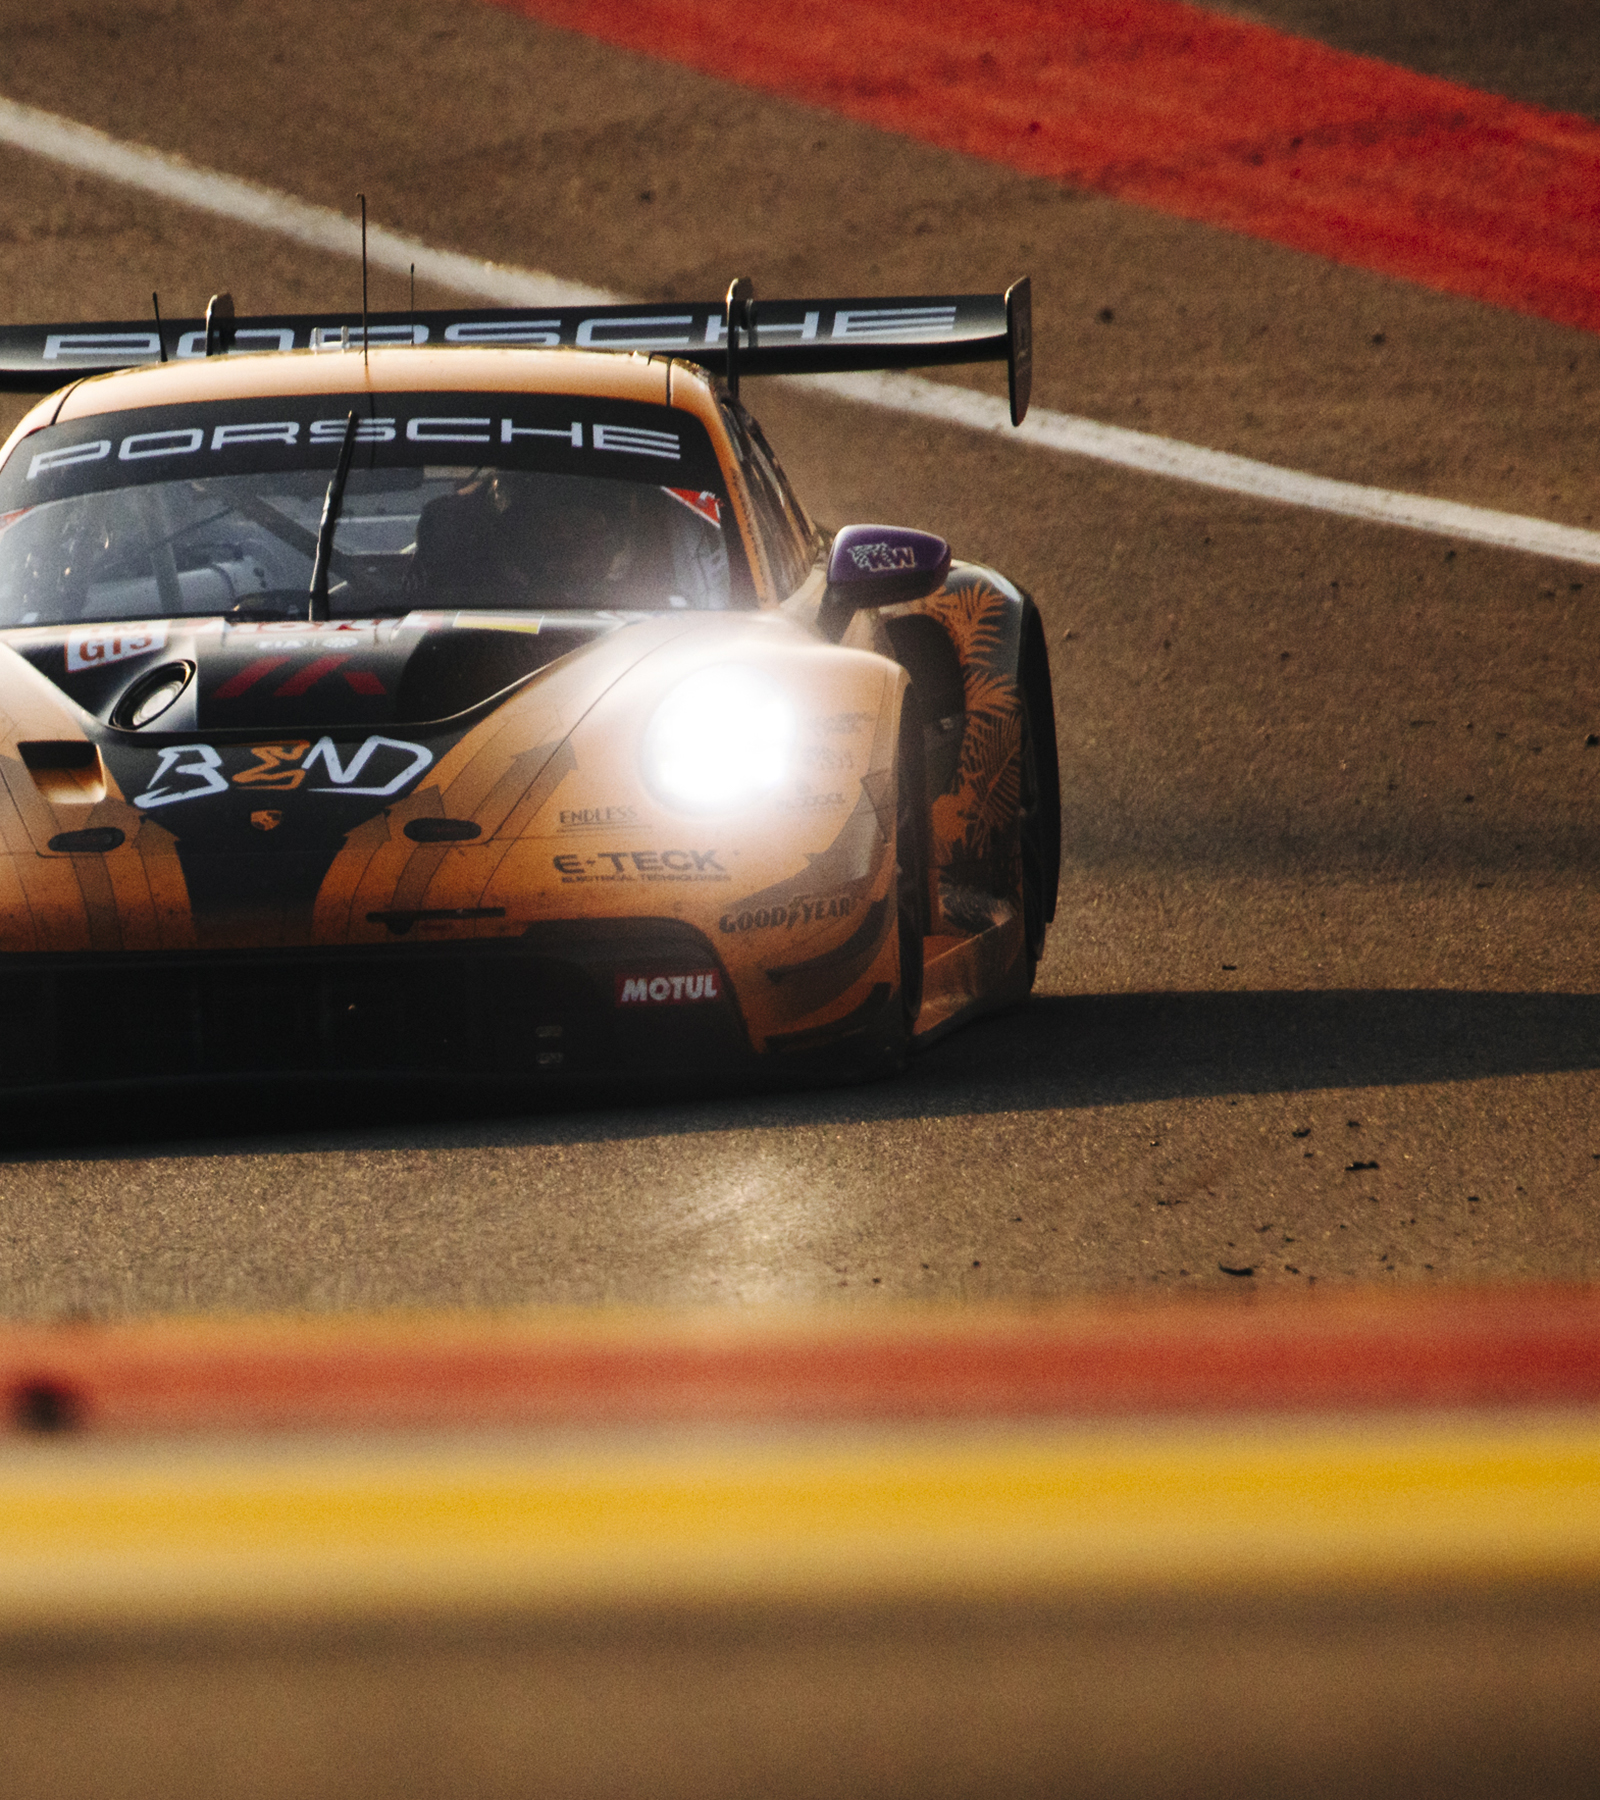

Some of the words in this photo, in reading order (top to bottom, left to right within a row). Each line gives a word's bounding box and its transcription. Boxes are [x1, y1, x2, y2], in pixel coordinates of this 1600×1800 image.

[41, 305, 957, 361] PORSCHE
[25, 416, 682, 481] PORSCHE
[560, 805, 638, 824] ENDLESS
[719, 896, 850, 933] GOODYEAR
[620, 974, 718, 1002] MOTUL
